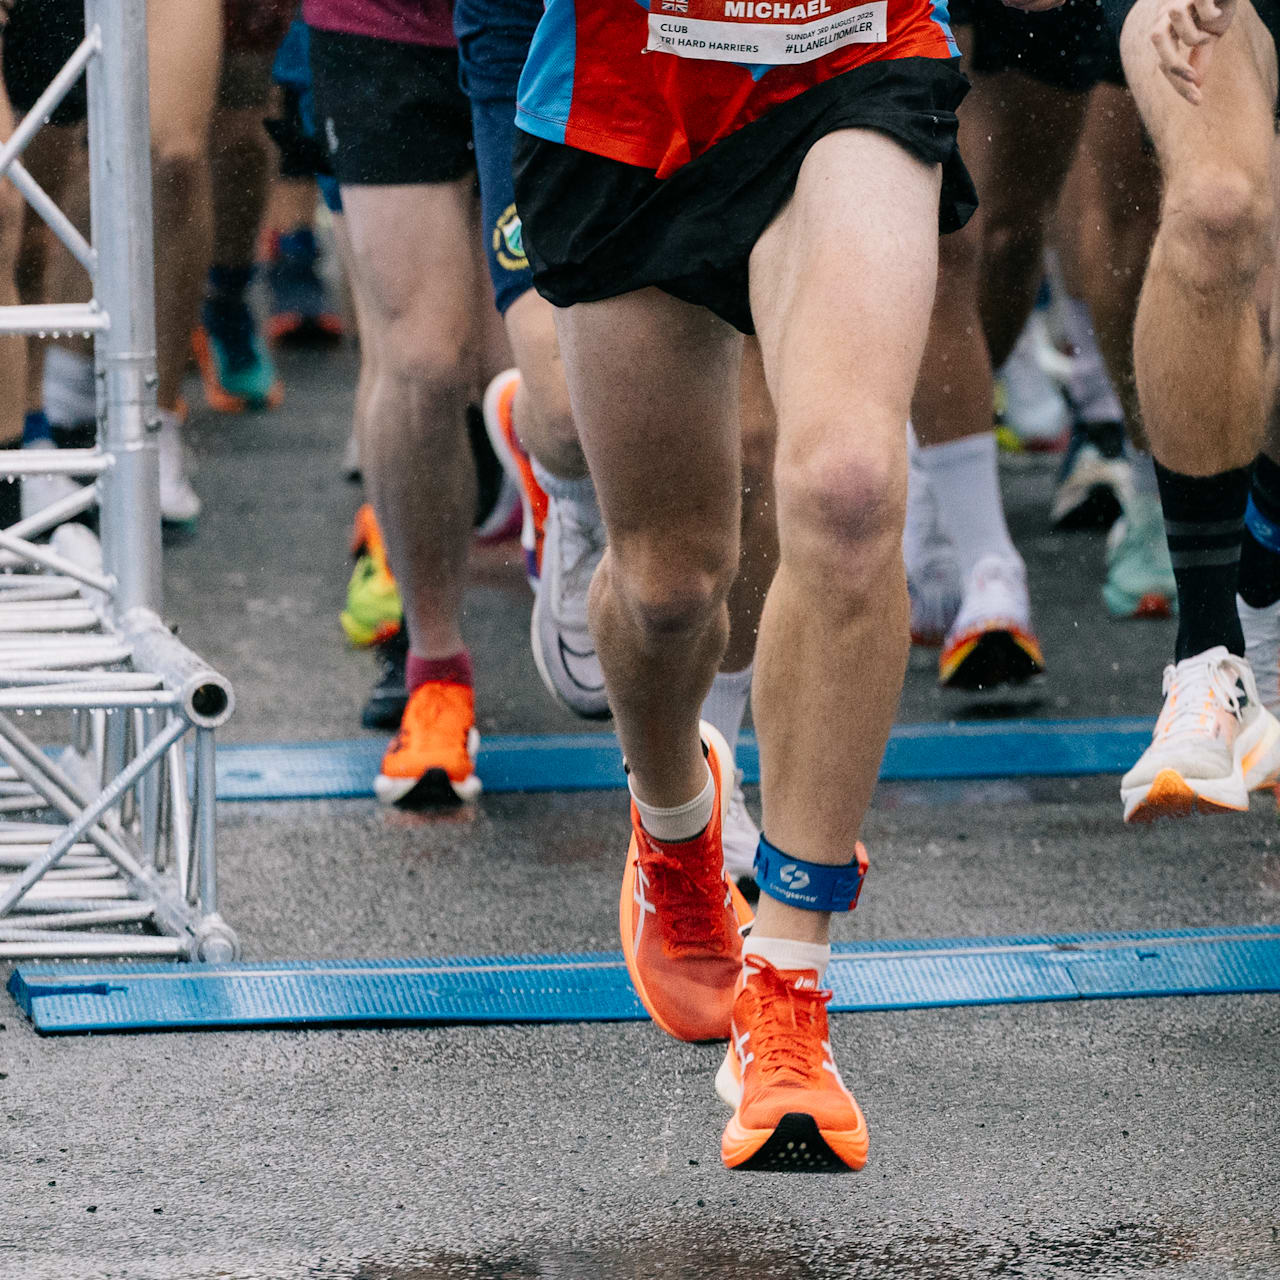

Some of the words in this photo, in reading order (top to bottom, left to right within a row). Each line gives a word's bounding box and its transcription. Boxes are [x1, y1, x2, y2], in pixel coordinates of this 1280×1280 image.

[660, 23, 689, 34] CLUB
[785, 29, 816, 41] SUNDAY
[830, 17, 856, 31] AUGUST
[856, 11, 875, 22] 2025
[677, 37, 706, 48] HARD
[708, 40, 759, 53] HARRIERS
